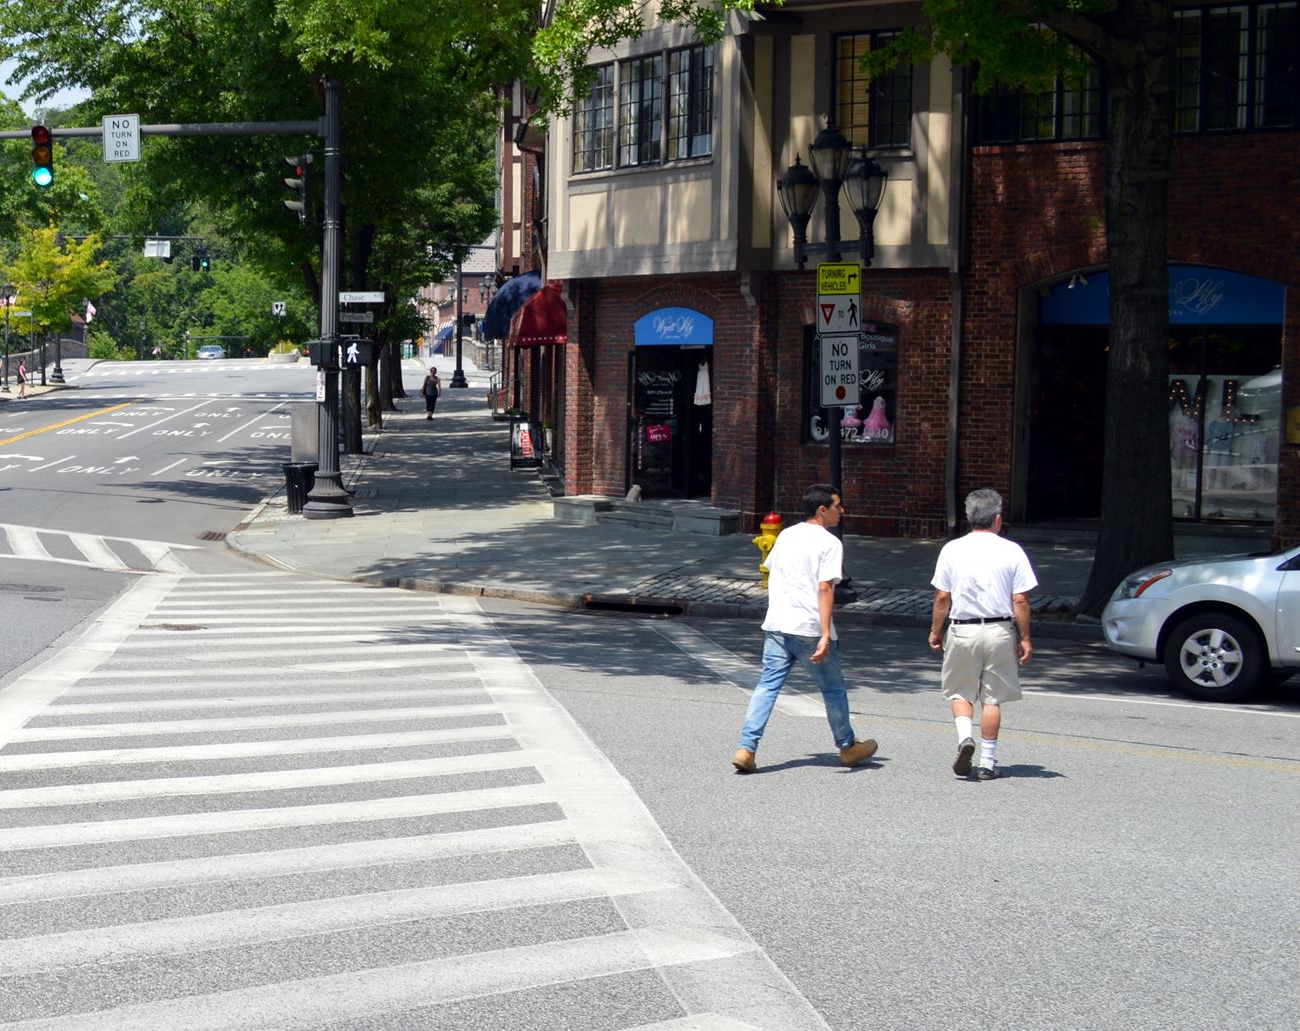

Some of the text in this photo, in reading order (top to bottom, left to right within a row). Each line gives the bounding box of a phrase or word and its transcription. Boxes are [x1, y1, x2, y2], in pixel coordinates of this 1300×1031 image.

[112, 119, 130, 129] NO
[111, 131, 132, 139] TURN
[116, 140, 128, 148] ON
[114, 150, 130, 158] RED
[821, 268, 846, 280] TURNING
[820, 281, 847, 291] VEHICLES
[343, 293, 365, 301] Chase
[1175, 278, 1225, 315] Lily
[837, 310, 845, 319] TO
[860, 332, 894, 344] Boutique
[832, 343, 848, 356] NO
[830, 360, 852, 371] TURN
[824, 373, 857, 386] ON RED
[860, 369, 884, 391] Lily
[151, 429, 213, 437] ONLY
[250, 431, 292, 439] ONL
[57, 465, 140, 475] ONLY
